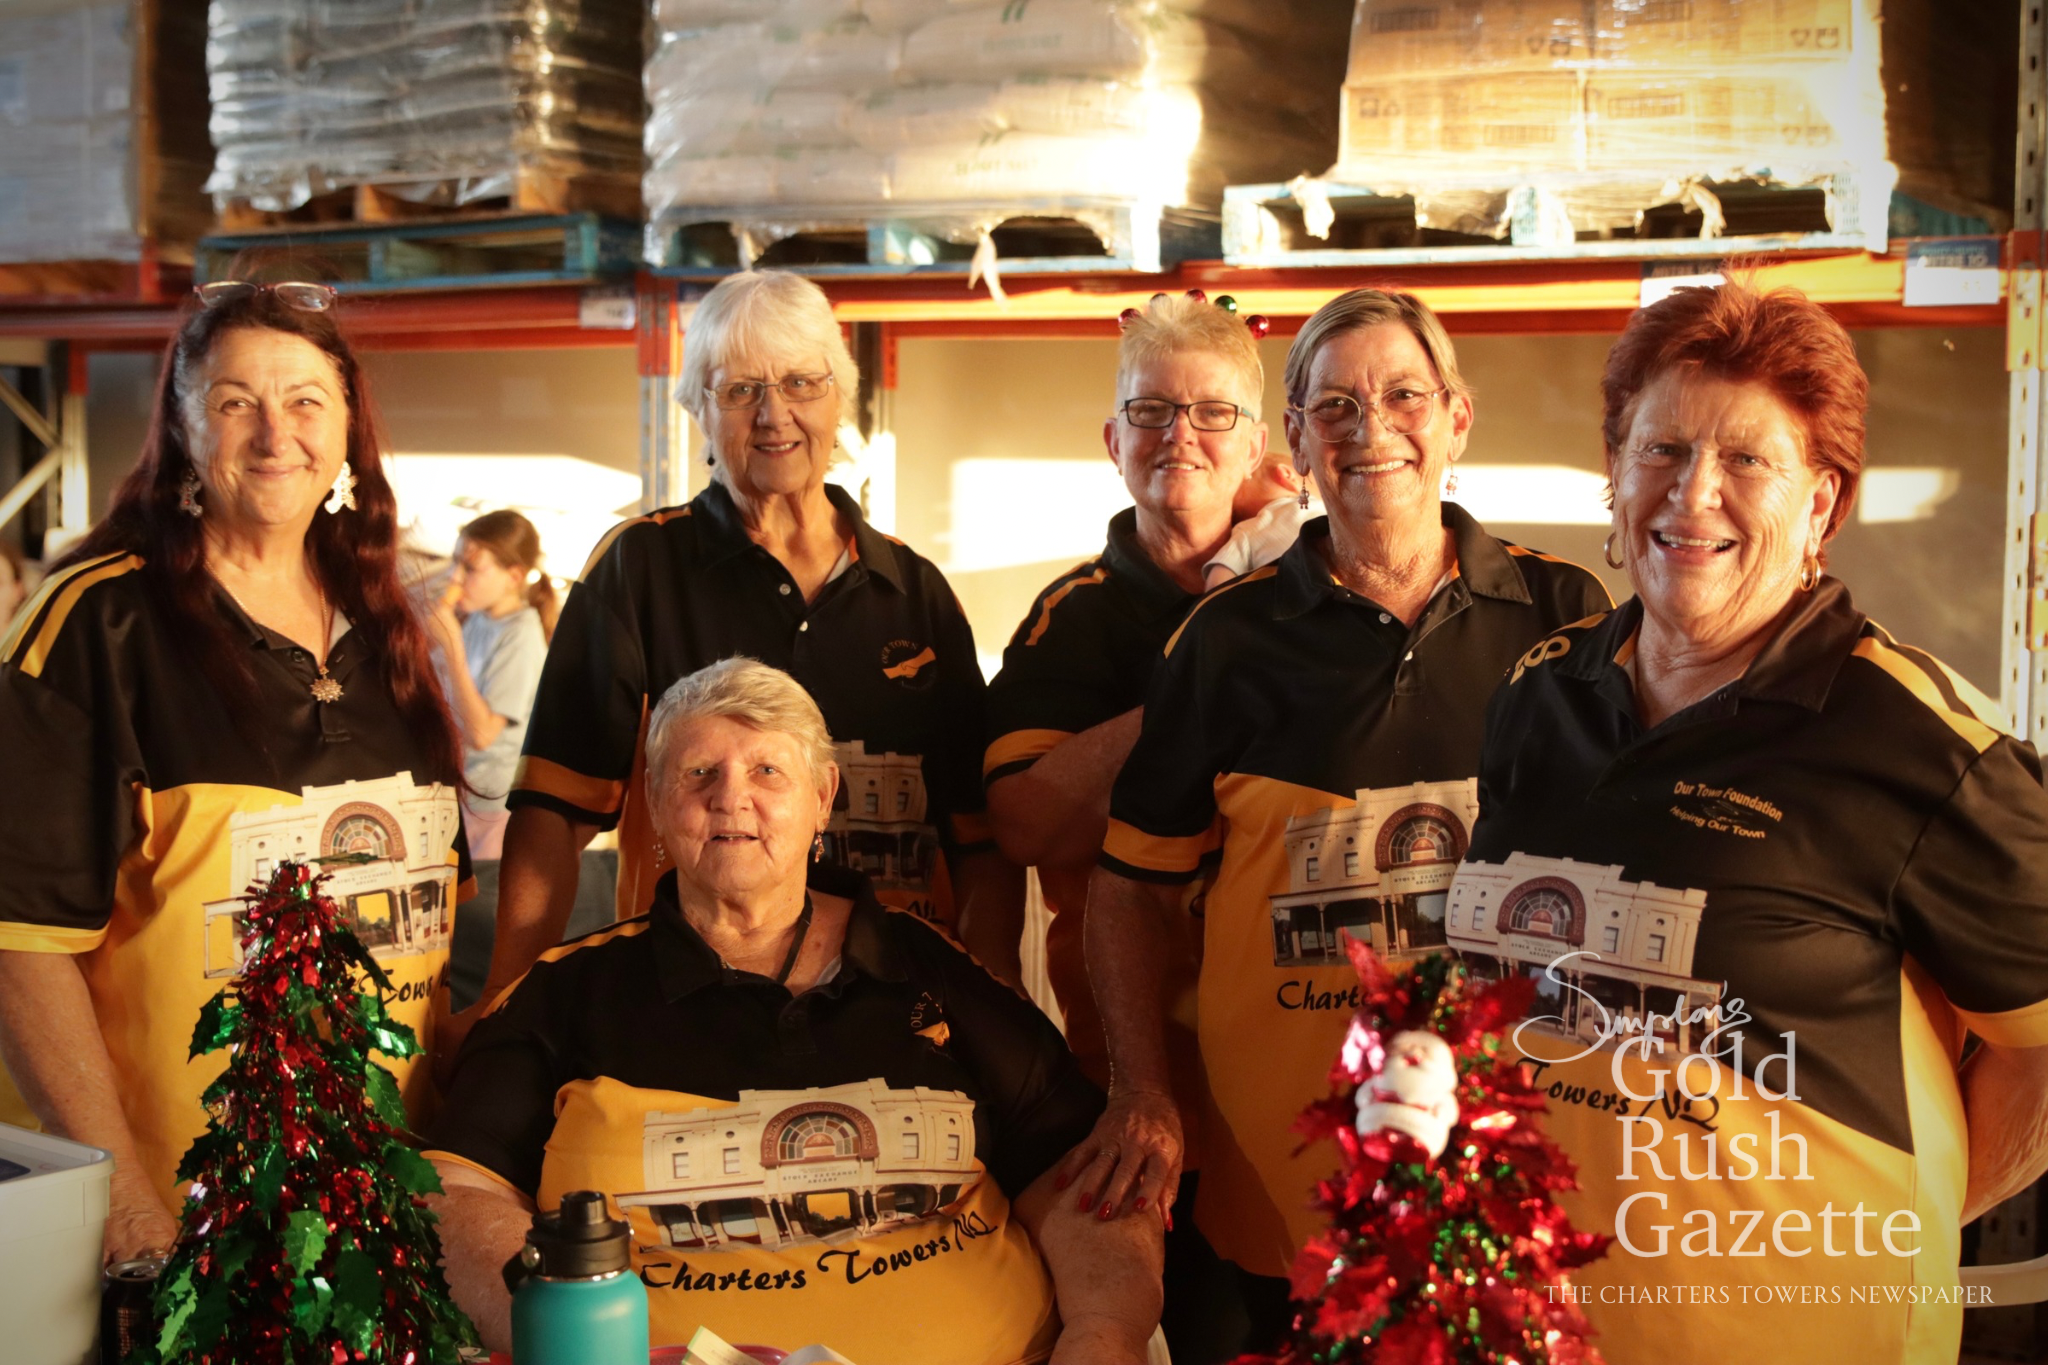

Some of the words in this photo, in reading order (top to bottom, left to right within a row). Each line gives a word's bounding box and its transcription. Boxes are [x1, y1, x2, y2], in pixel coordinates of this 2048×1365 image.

[1669, 805, 1706, 827] Helping
[1707, 819, 1730, 832] Our
[1732, 824, 1766, 838] Town
[1674, 781, 1695, 795] Our
[1696, 783, 1723, 798] Town
[1723, 787, 1783, 822] Foundation
[1515, 1057, 1631, 1115] Towers
[640, 1262, 807, 1291] Charters
[817, 1235, 951, 1285] Towers
[953, 1210, 998, 1251] NQ
